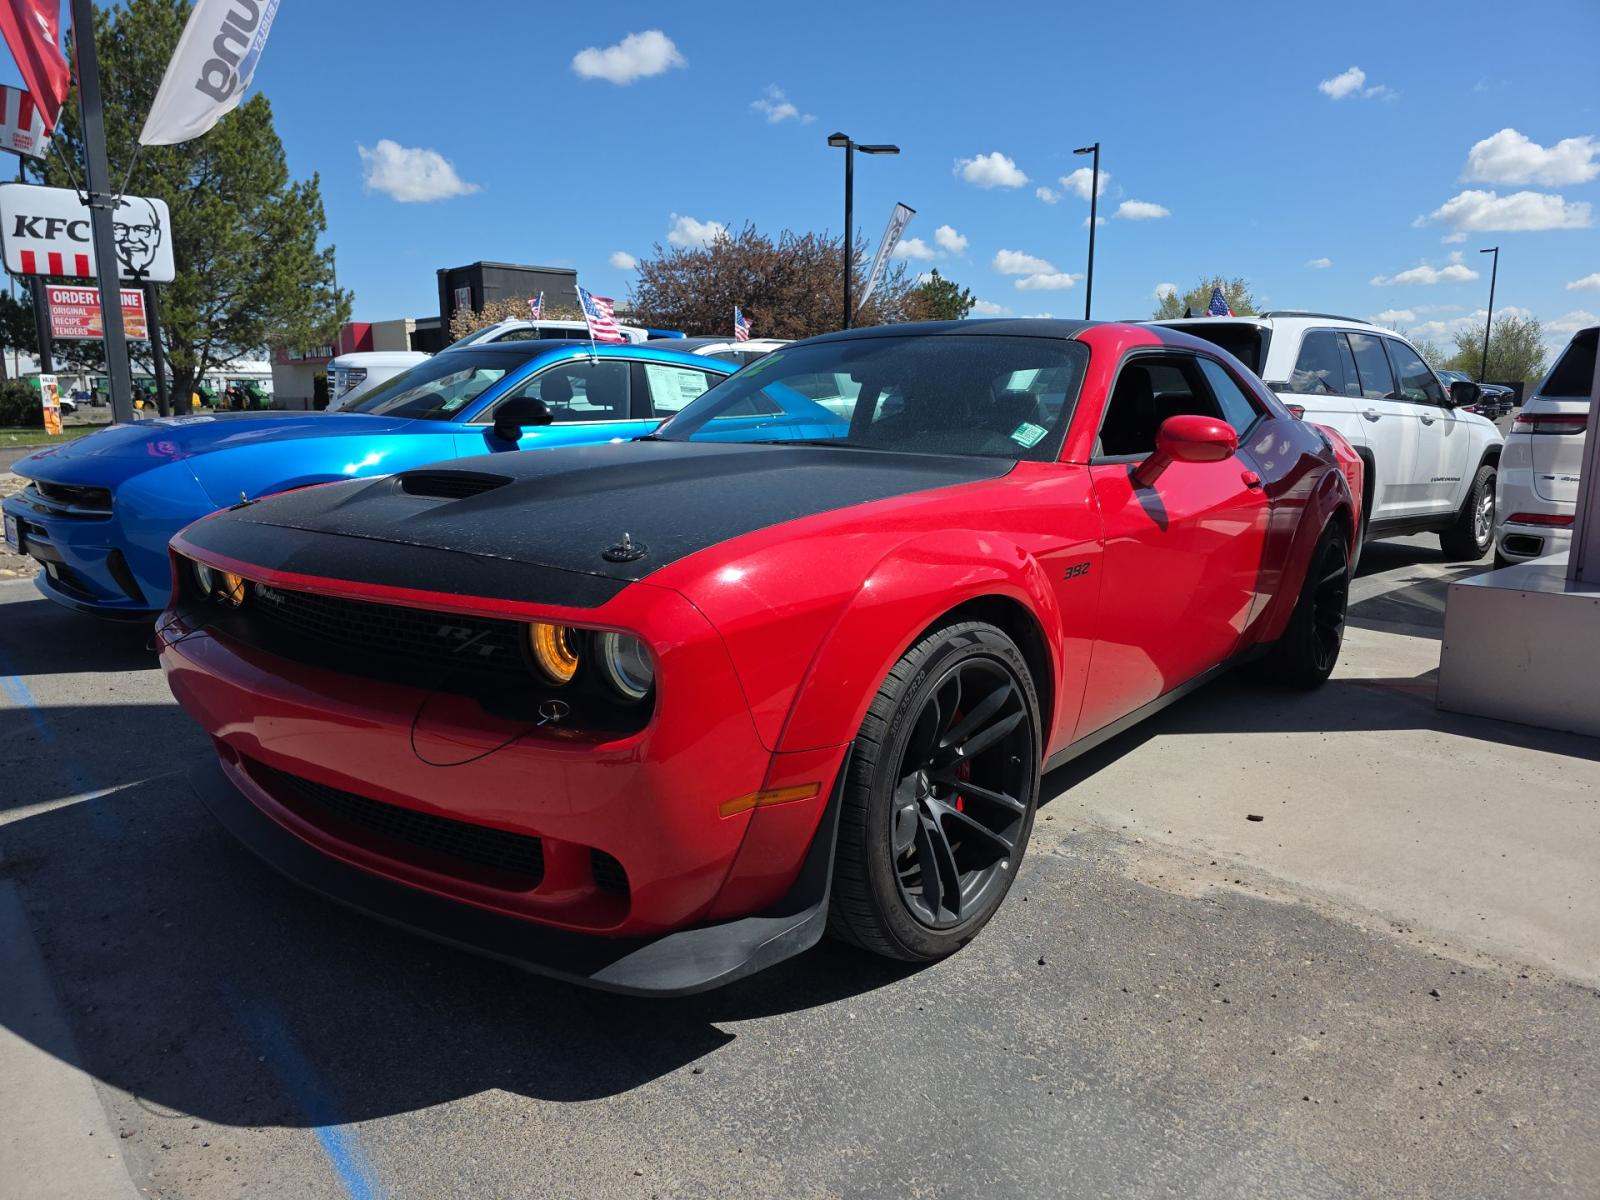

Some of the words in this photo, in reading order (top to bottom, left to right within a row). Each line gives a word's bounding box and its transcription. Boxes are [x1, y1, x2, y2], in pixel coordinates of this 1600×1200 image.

[12, 215, 90, 242] KFC
[52, 290, 95, 305] ORDER
[52, 306, 88, 316] ORIGINAL
[54, 316, 81, 326] RECIPE
[54, 326, 88, 336] TENDERS
[1063, 562, 1091, 580] 392
[437, 625, 505, 656] R/T
